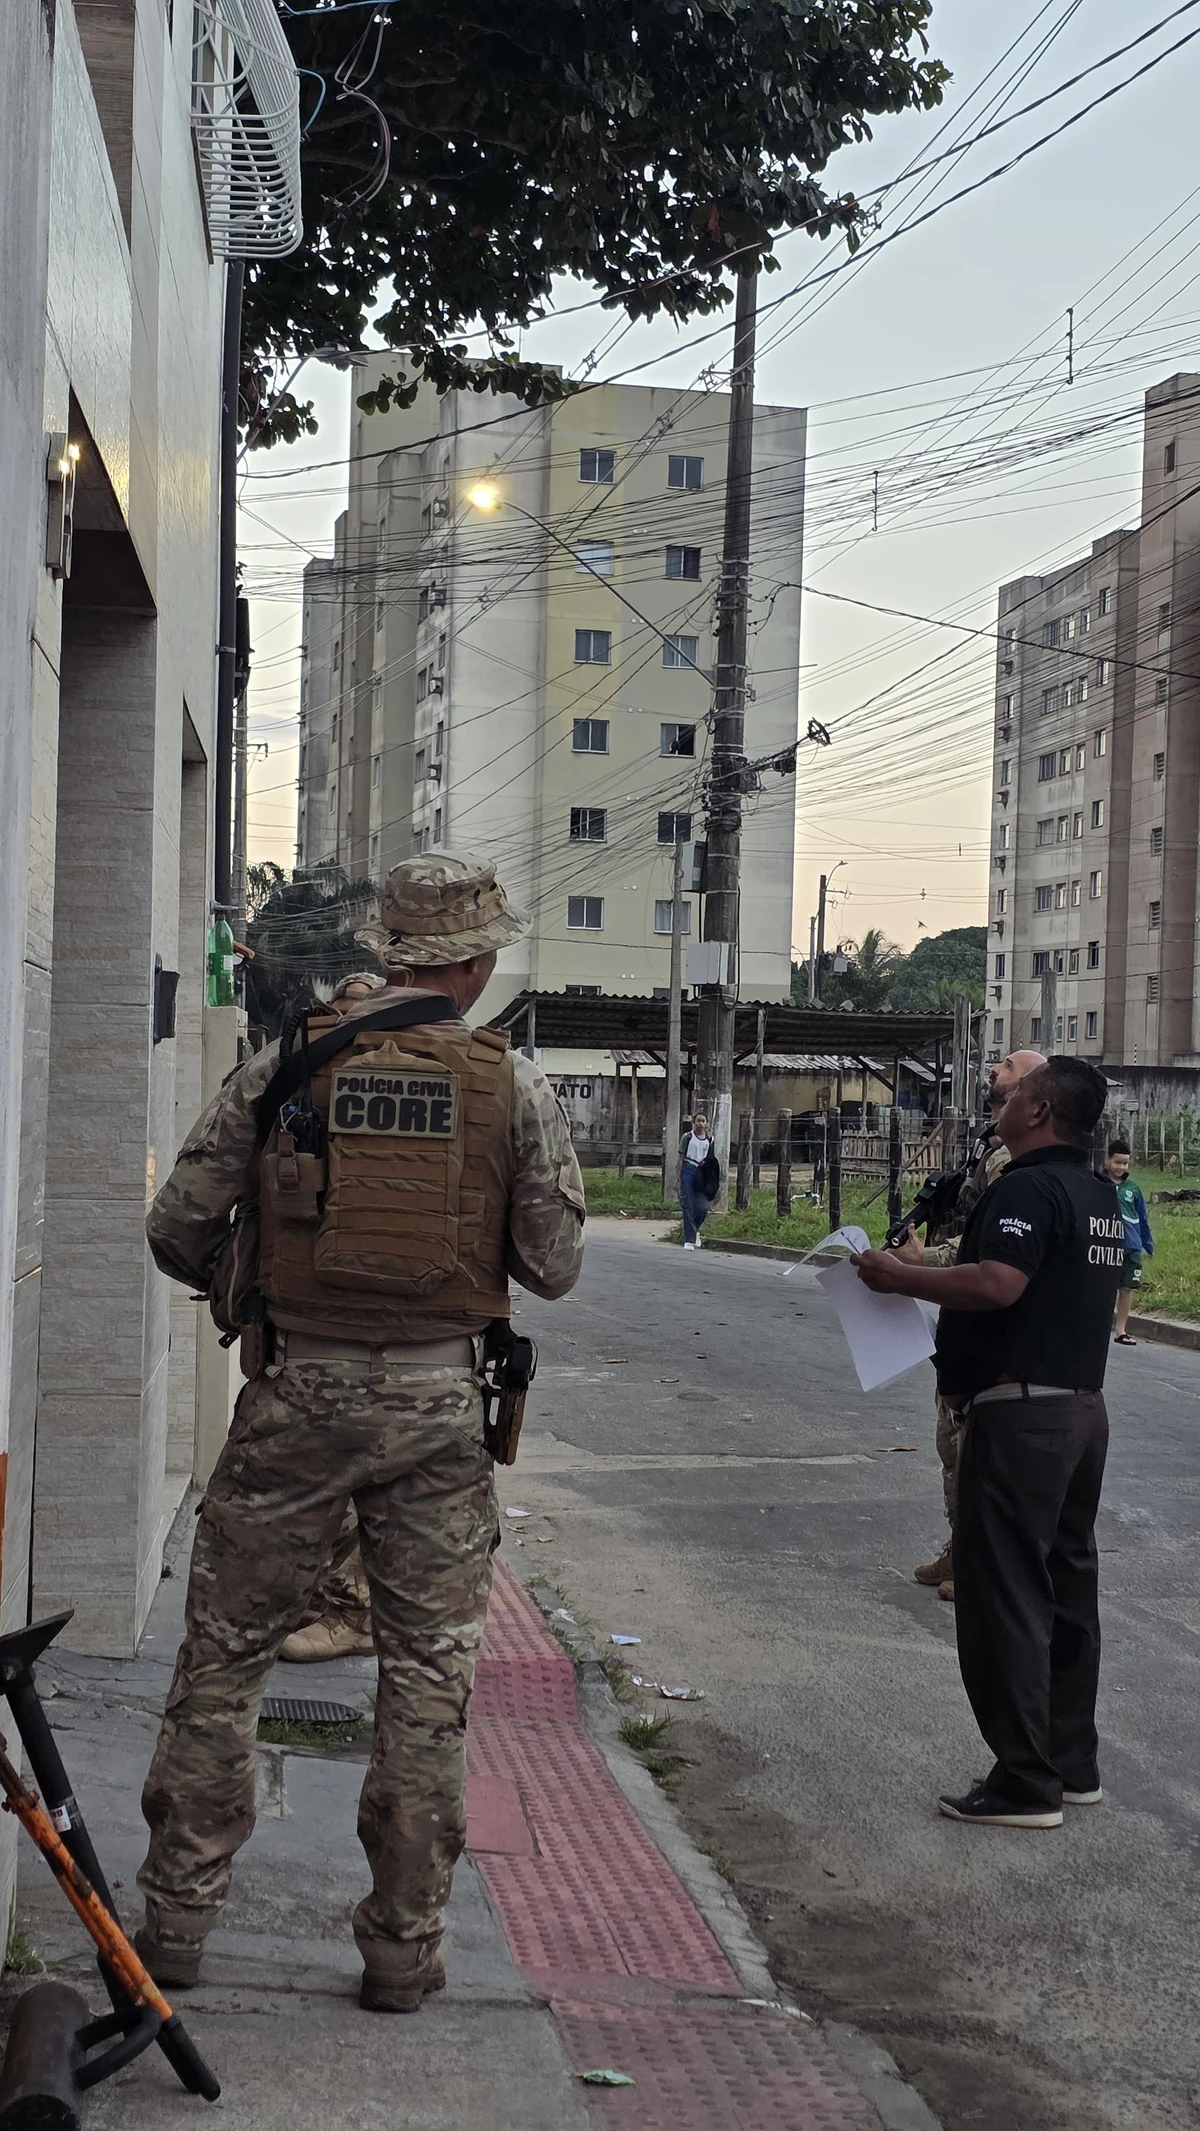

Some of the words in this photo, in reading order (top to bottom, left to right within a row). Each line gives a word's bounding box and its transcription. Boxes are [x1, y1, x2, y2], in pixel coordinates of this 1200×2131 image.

[337, 1076, 404, 1095] POLÍCIA
[407, 1081, 453, 1097] CIVIL
[334, 1094, 452, 1133] CORE
[999, 1218, 1032, 1232] POLÍCIA
[1002, 1226, 1024, 1237] CIVIL
